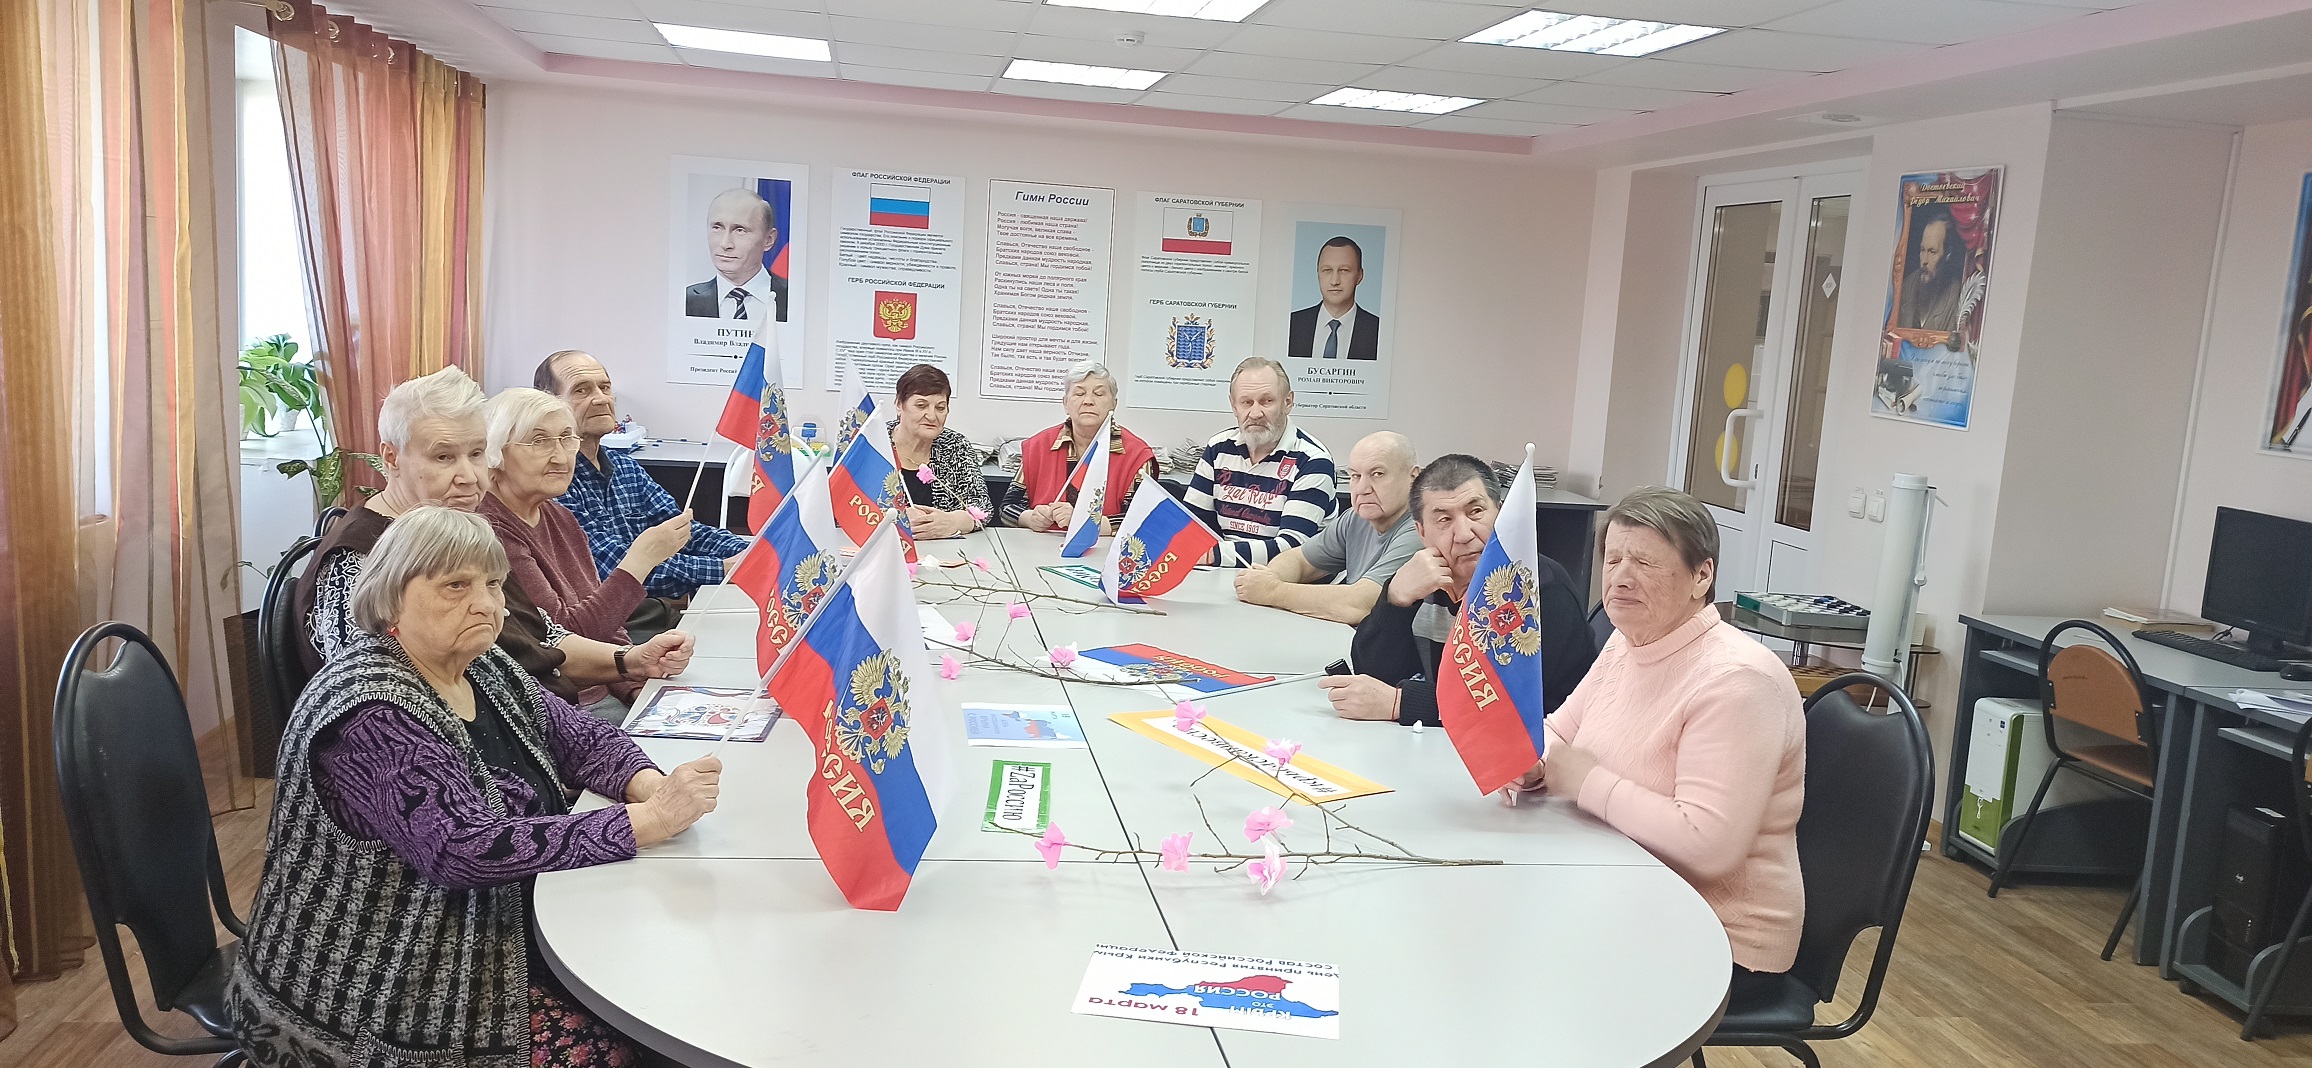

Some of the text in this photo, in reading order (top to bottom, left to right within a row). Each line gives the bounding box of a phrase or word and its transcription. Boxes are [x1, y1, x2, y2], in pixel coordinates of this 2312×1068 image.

[870, 172, 913, 182] РОССИЙСКОЙ
[913, 176, 951, 185] ФЕДЕРАЦИИ
[1015, 191, 1090, 206] Гимн России
[1171, 198, 1214, 206] САРАТОВСКОЙ
[1214, 200, 1245, 208] ГУБЕРНИИ
[848, 276, 945, 290] ГЕРБ РОССИЙСКОЙ ФЕДЕРАЦИИ
[1165, 300, 1207, 308] САРАТОВСКОЙ
[694, 338, 728, 347] Владимир
[690, 366, 718, 374] Президент
[1307, 367, 1356, 376] БУСАРГИН
[1229, 520, 1246, 532] SINCE
[1138, 955, 1227, 968] Республики
[1182, 952, 1273, 966] Российской
[1278, 960, 1333, 970] состав
[1232, 964, 1302, 974] принятия
[1193, 985, 1282, 1002] РОССИЯ
[1088, 996, 1199, 1016] 18 марта
[1251, 1000, 1275, 1008] ЭТО
[1228, 1005, 1292, 1020] КРЫМ
